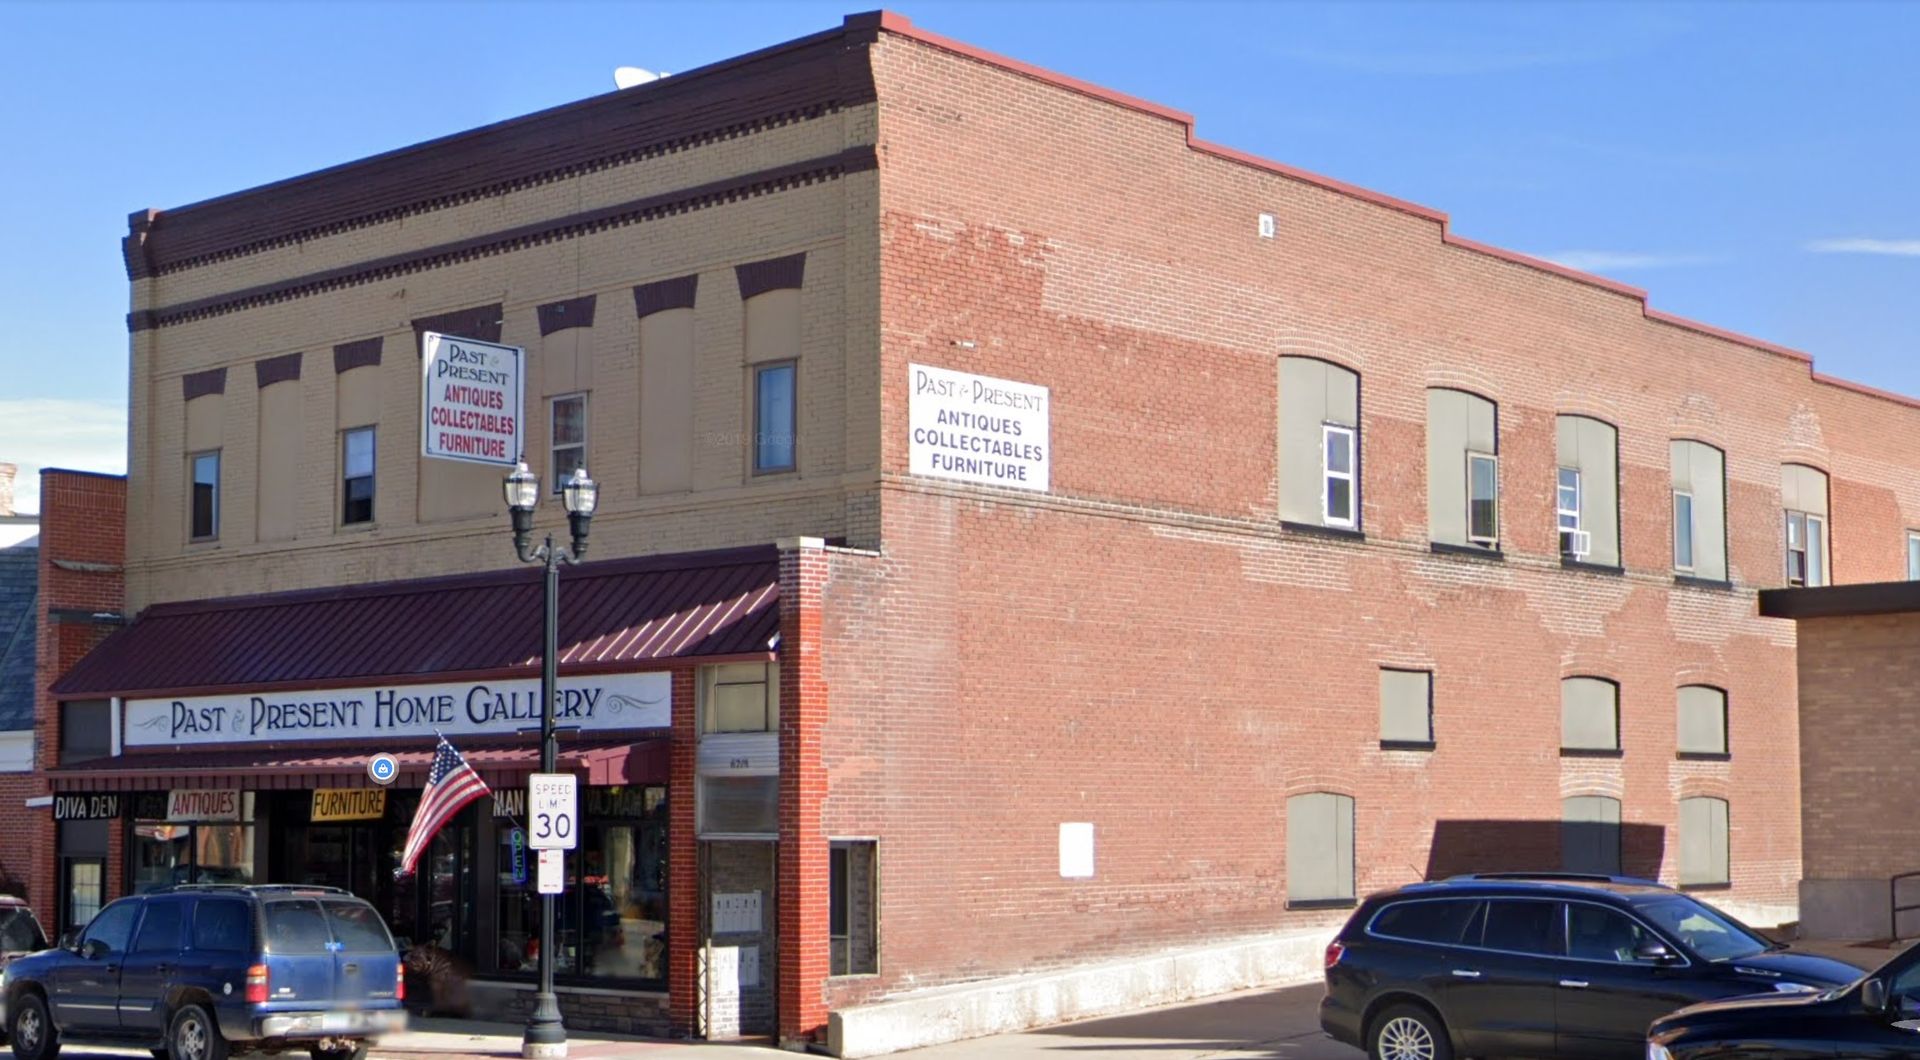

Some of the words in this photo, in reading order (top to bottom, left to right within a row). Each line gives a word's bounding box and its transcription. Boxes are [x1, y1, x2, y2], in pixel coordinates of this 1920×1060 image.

[449, 344, 487, 366] PAST
[437, 359, 509, 386] PRESENT
[444, 384, 504, 410] ANTIQUES
[916, 370, 956, 397] PAST
[973, 380, 1043, 412] PRESENT
[431, 406, 514, 436] COLLECTABLES
[937, 408, 1022, 437] ANTIQUES
[439, 432, 506, 458] FURNITURE
[914, 427, 1043, 462] COLLECTABLES
[932, 453, 1027, 482] FURNITURE
[171, 701, 226, 738] PAST
[250, 696, 364, 735] PRESENT
[374, 690, 456, 728] HOME
[171, 791, 236, 815] ANTIQUES
[313, 789, 384, 817] FURNITURE
[493, 789, 525, 817] MAN
[536, 784, 571, 795] SPEED
[55, 797, 86, 819] DIVA
[90, 795, 118, 818] DEN
[539, 798, 567, 809] LMT
[536, 813, 571, 839] 30
[512, 830, 524, 880] OPEN
